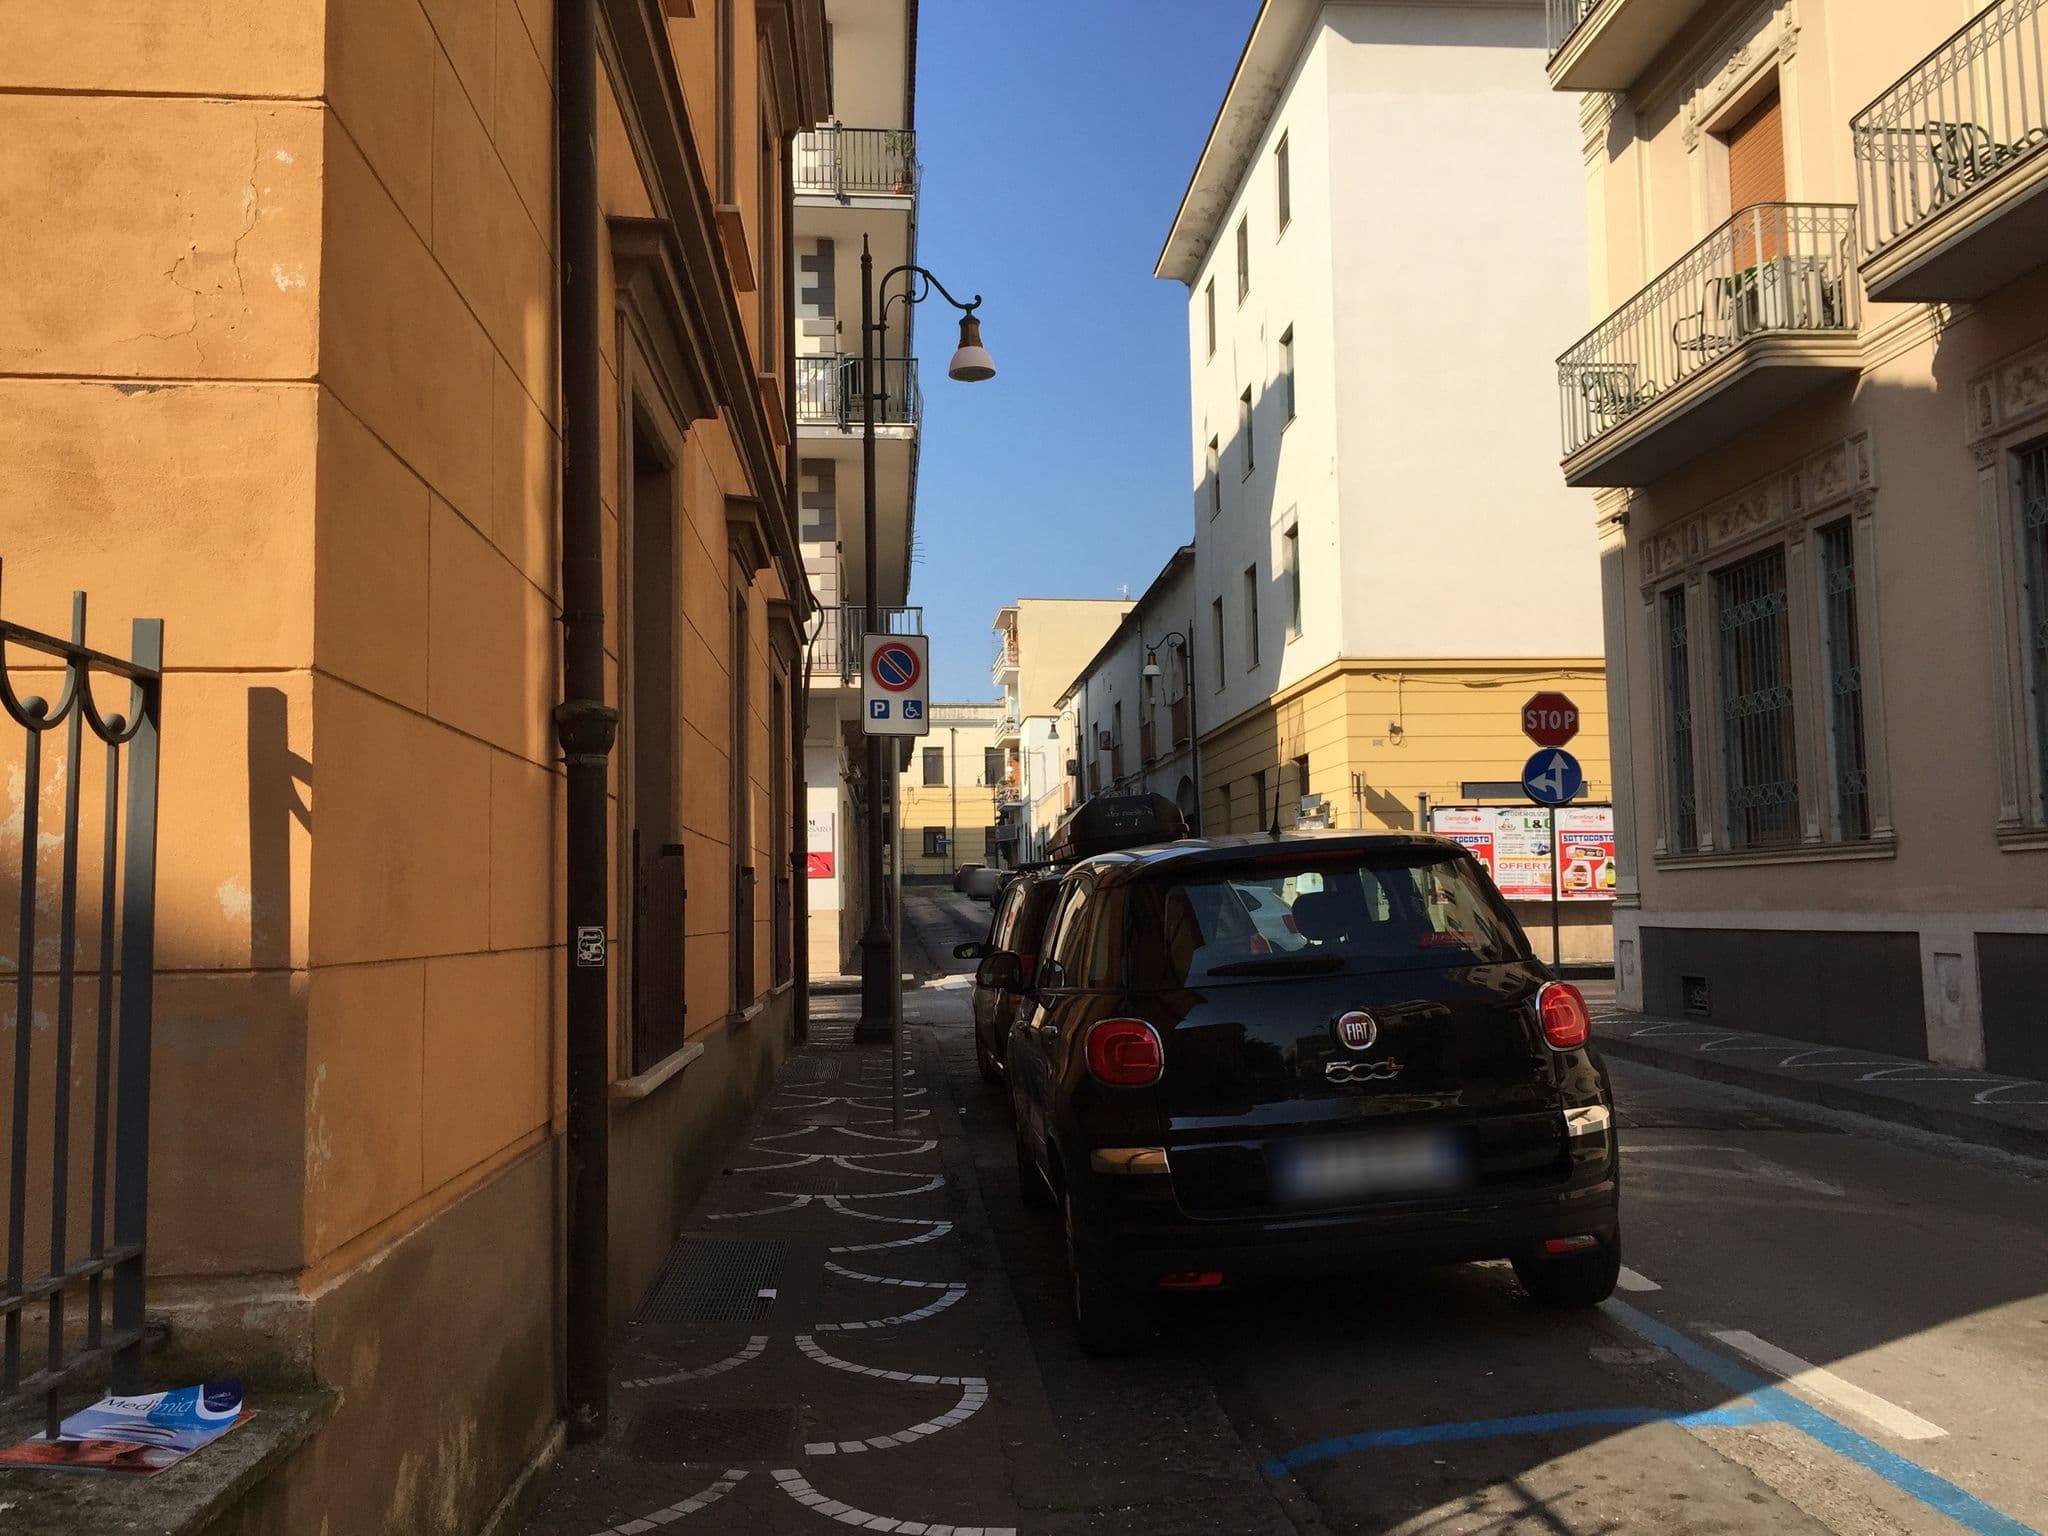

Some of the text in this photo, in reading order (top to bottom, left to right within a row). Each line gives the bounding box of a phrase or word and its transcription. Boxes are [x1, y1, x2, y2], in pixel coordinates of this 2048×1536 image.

[874, 701, 886, 717] P
[1526, 709, 1576, 730] STOP
[1563, 834, 1616, 842] SOTTOCOSTO
[1345, 1022, 1368, 1041] FIAT
